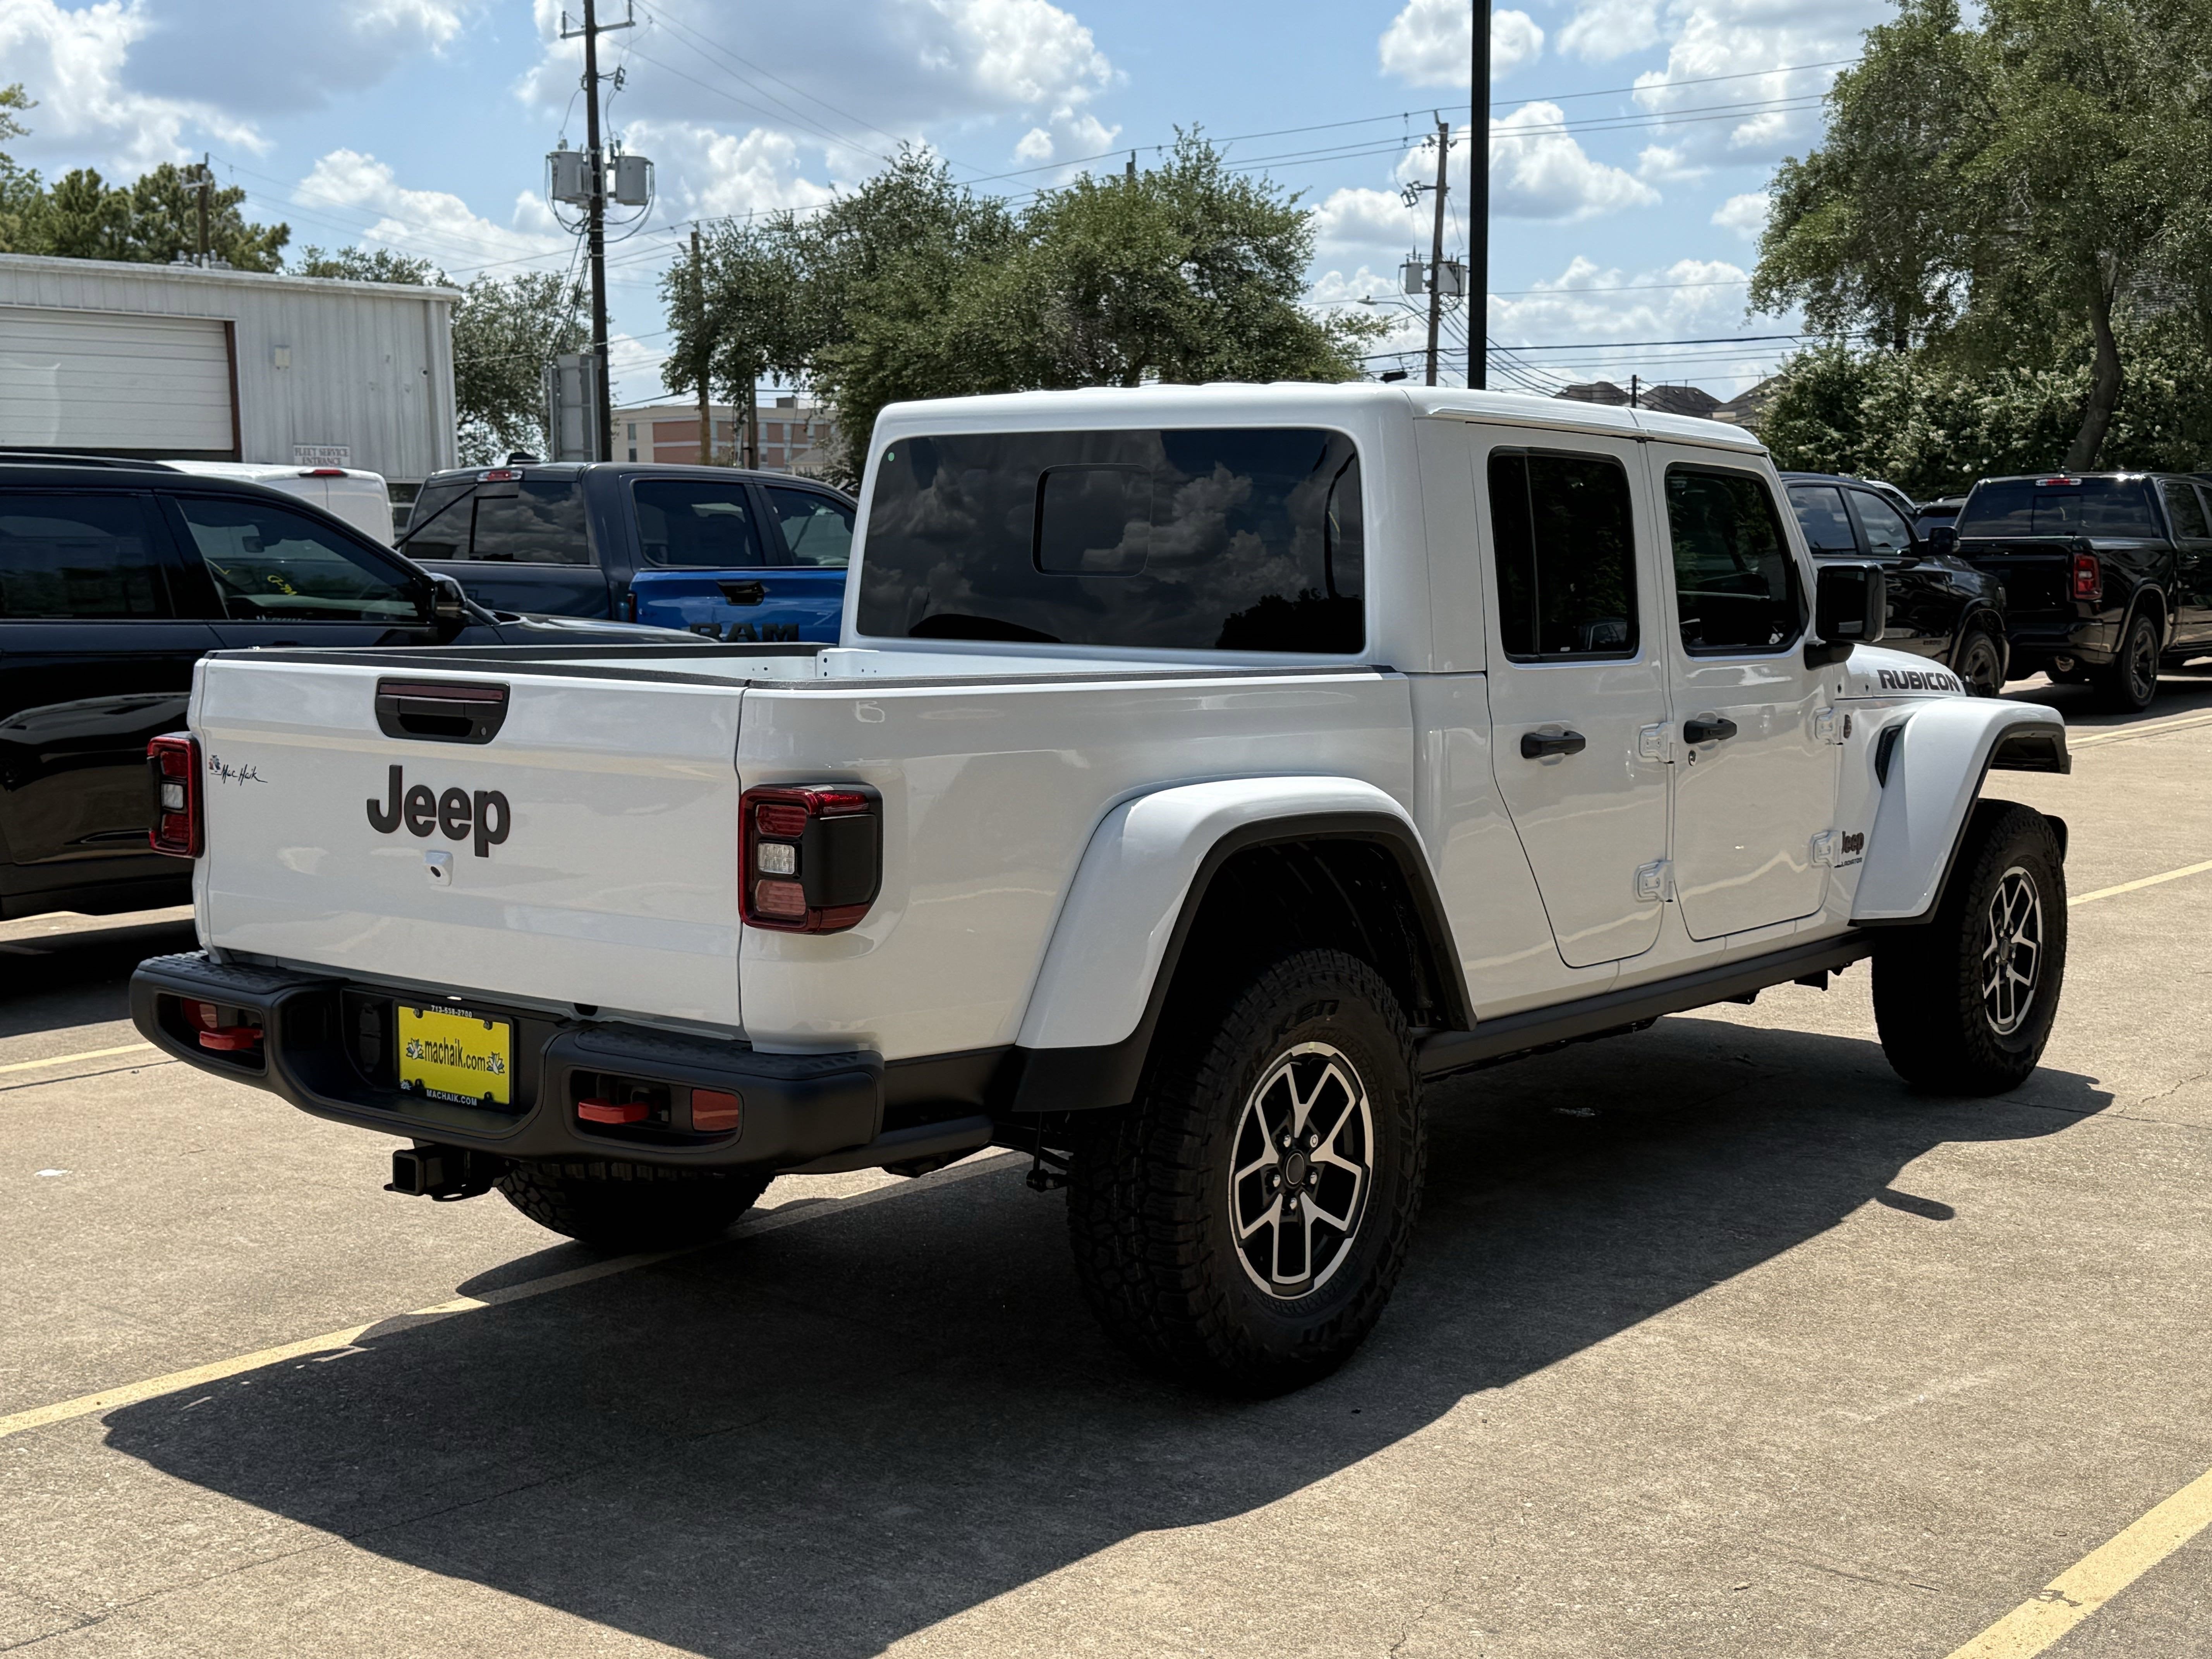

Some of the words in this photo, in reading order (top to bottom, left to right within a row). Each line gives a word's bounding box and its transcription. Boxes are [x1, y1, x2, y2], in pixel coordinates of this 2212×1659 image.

[295, 447, 316, 456] FLEET
[319, 448, 348, 457] SERVICE
[302, 457, 341, 465] ENTRANCE
[690, 622, 799, 642] RAM
[1877, 669, 1961, 692] RUBICON
[221, 764, 238, 784] Mac
[238, 764, 268, 786] Haik
[366, 764, 510, 858] Jeep
[425, 1037, 486, 1072] machaik.com
[426, 1089, 477, 1106] MACHAIK.COM
